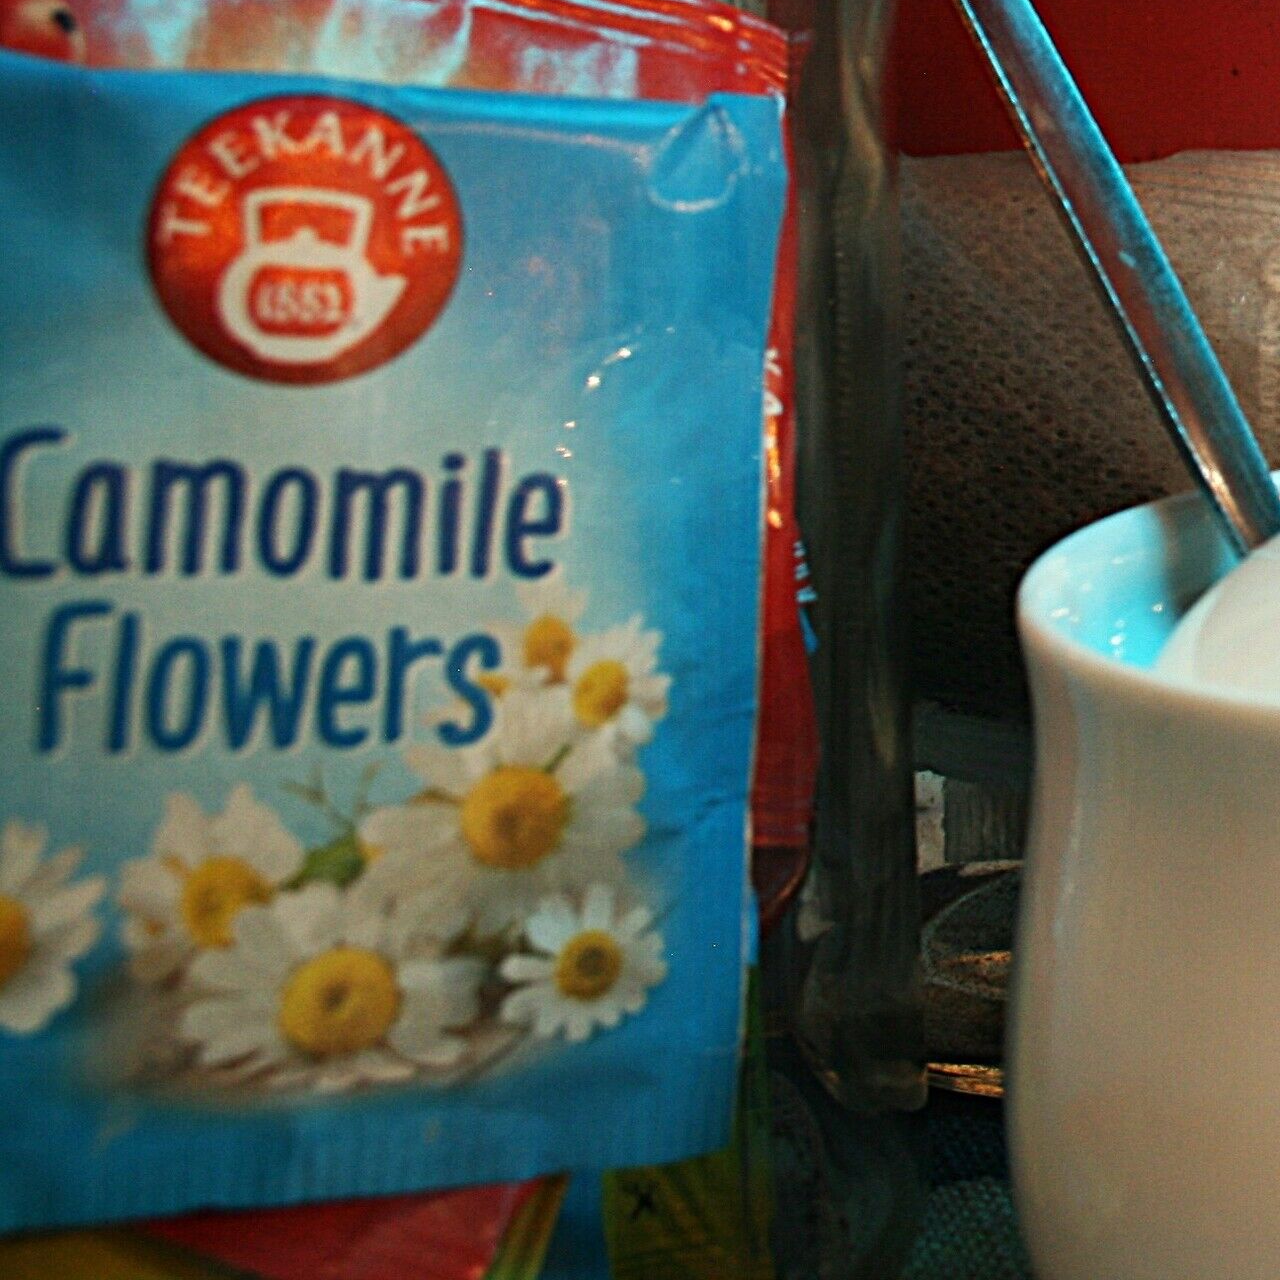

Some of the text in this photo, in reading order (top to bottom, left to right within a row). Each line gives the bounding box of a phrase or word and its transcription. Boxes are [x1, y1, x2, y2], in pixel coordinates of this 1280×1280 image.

[155, 110, 449, 257] TEEKANNE
[0, 425, 564, 580] Camomile
[38, 602, 503, 755] Flowers
